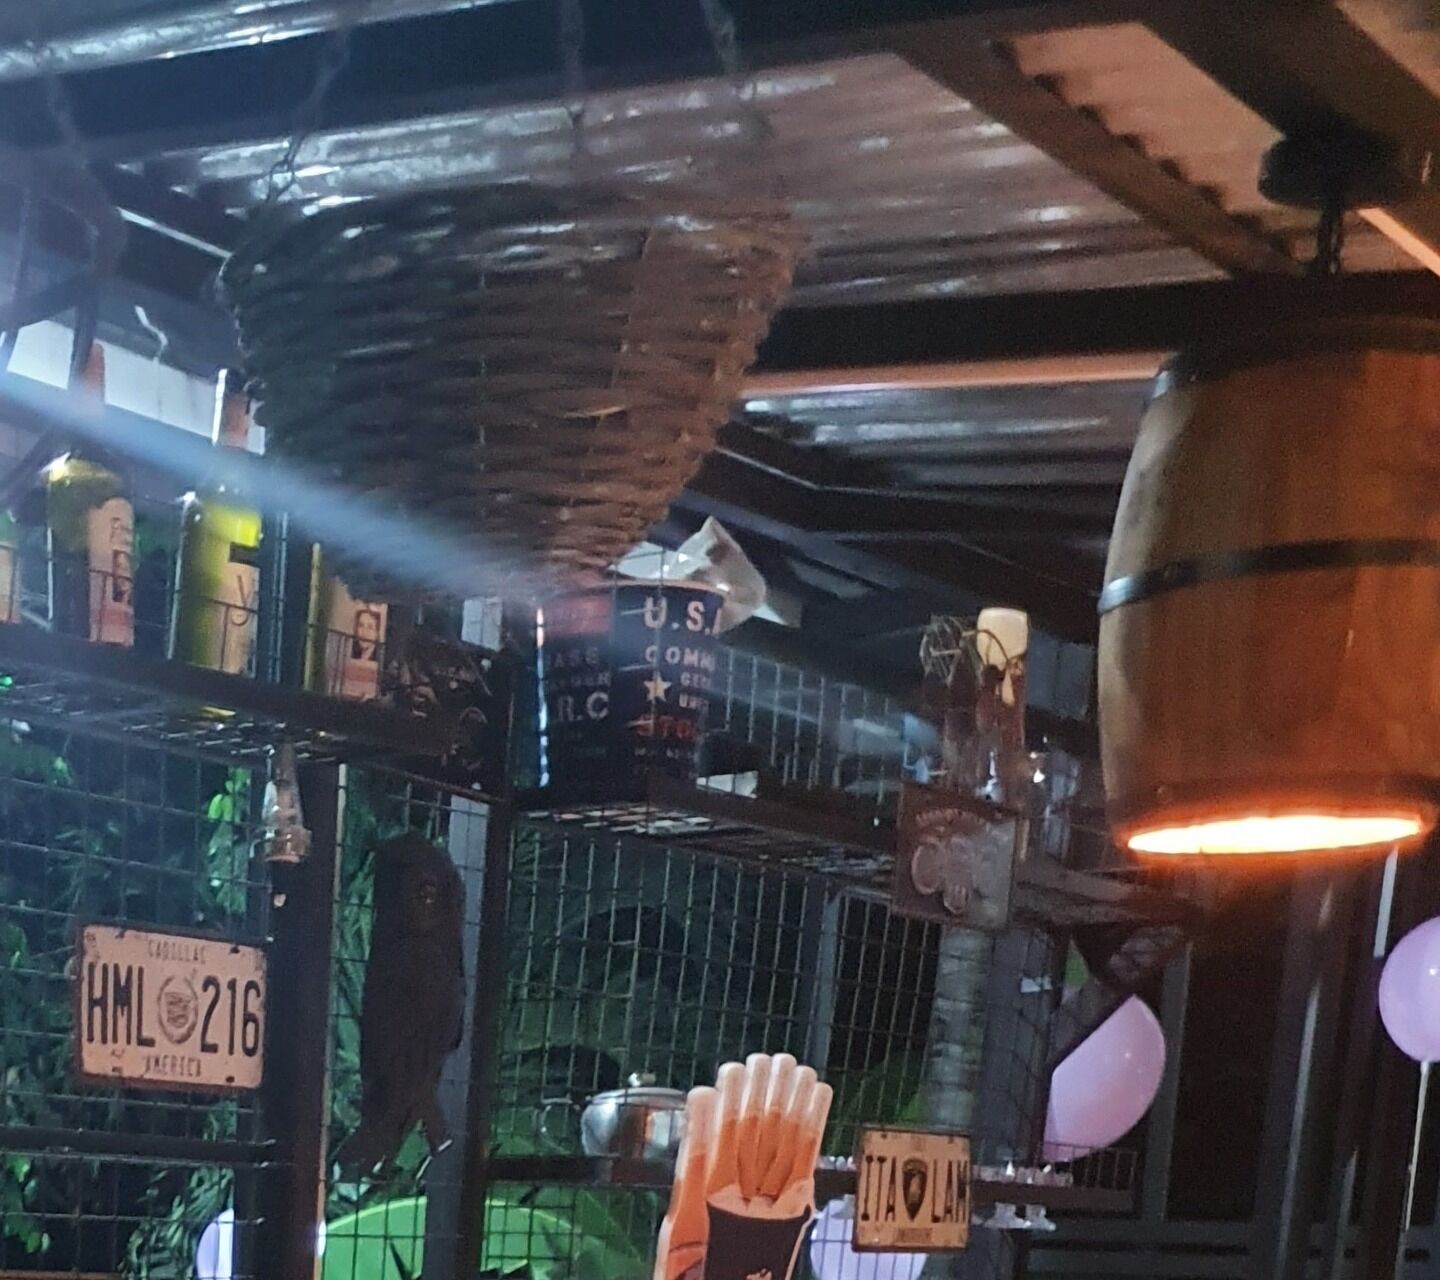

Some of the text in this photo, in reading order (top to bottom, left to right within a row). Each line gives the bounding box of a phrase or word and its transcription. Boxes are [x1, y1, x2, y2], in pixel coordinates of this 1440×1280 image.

[147, 938, 206, 965] CADILLAC
[87, 961, 262, 1058] HML 216
[144, 1055, 202, 1078] AMERICA
